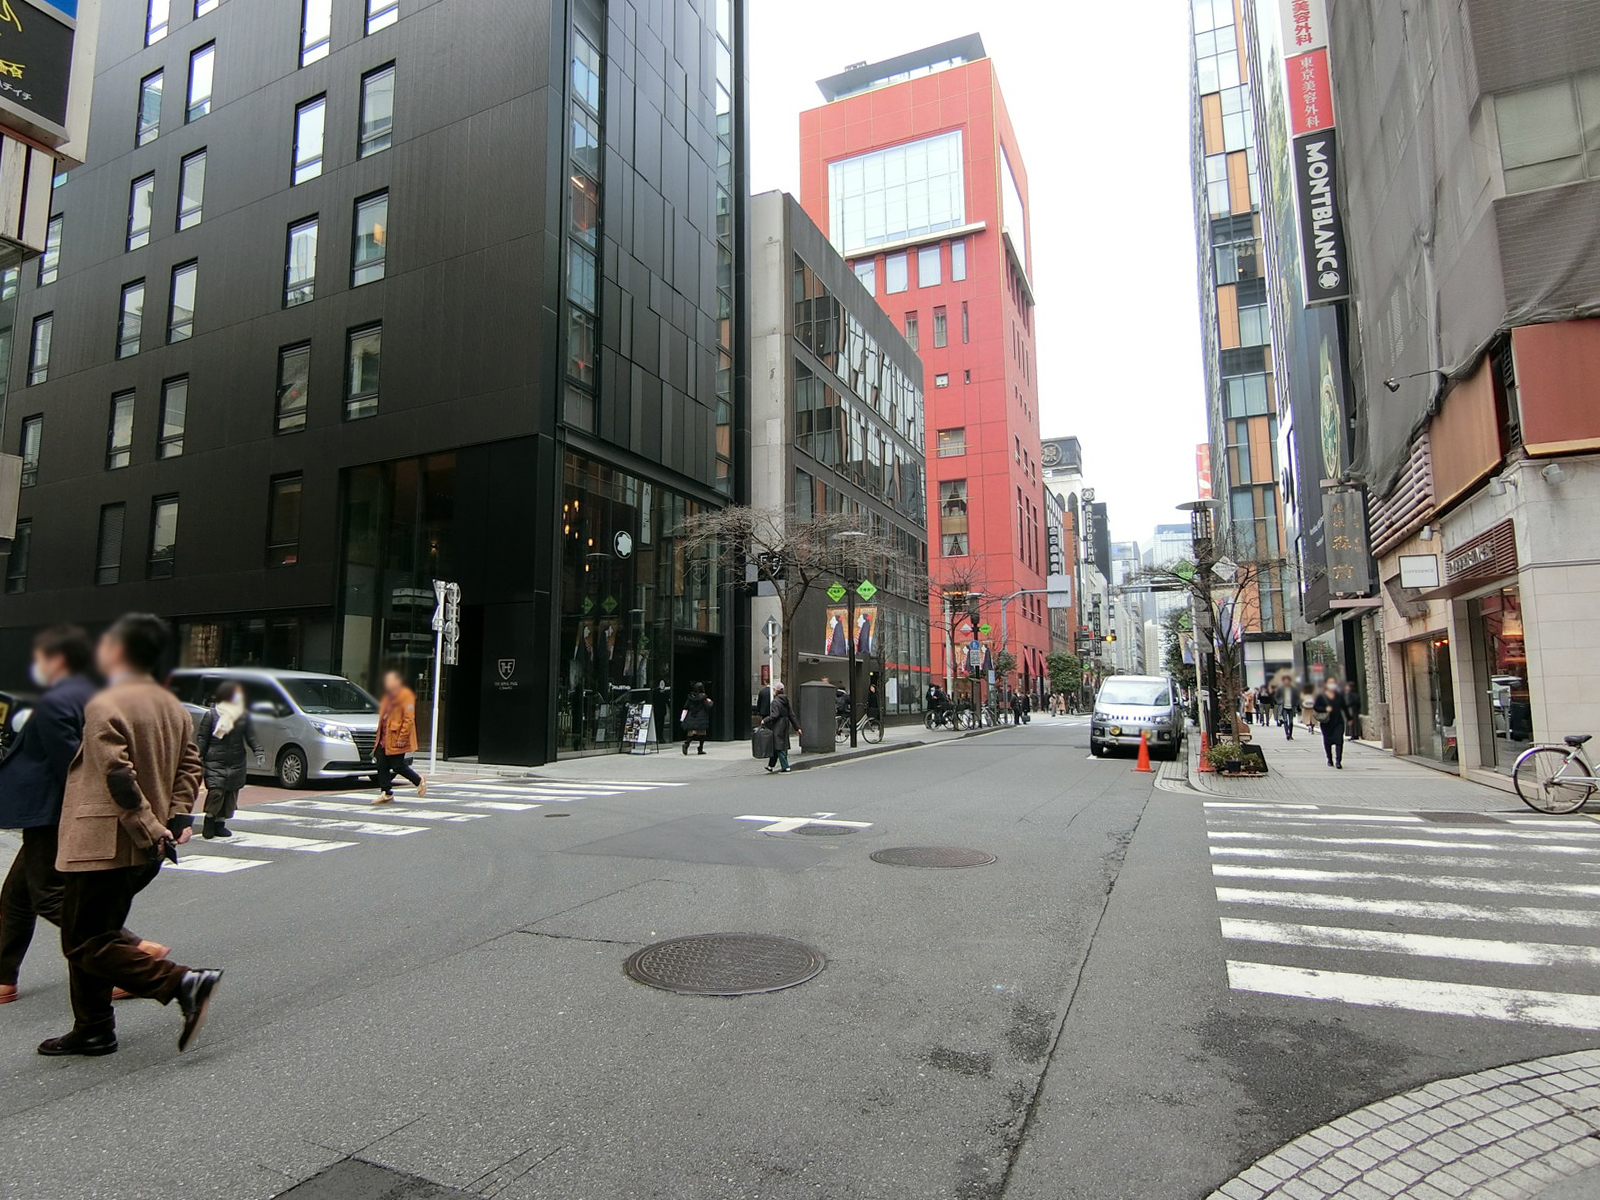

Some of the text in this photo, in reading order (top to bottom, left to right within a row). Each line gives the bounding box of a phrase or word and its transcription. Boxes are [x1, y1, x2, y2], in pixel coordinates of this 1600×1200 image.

[1299, 56, 1320, 128] 東京美容外科
[1305, 141, 1338, 272] MONTBLANC
